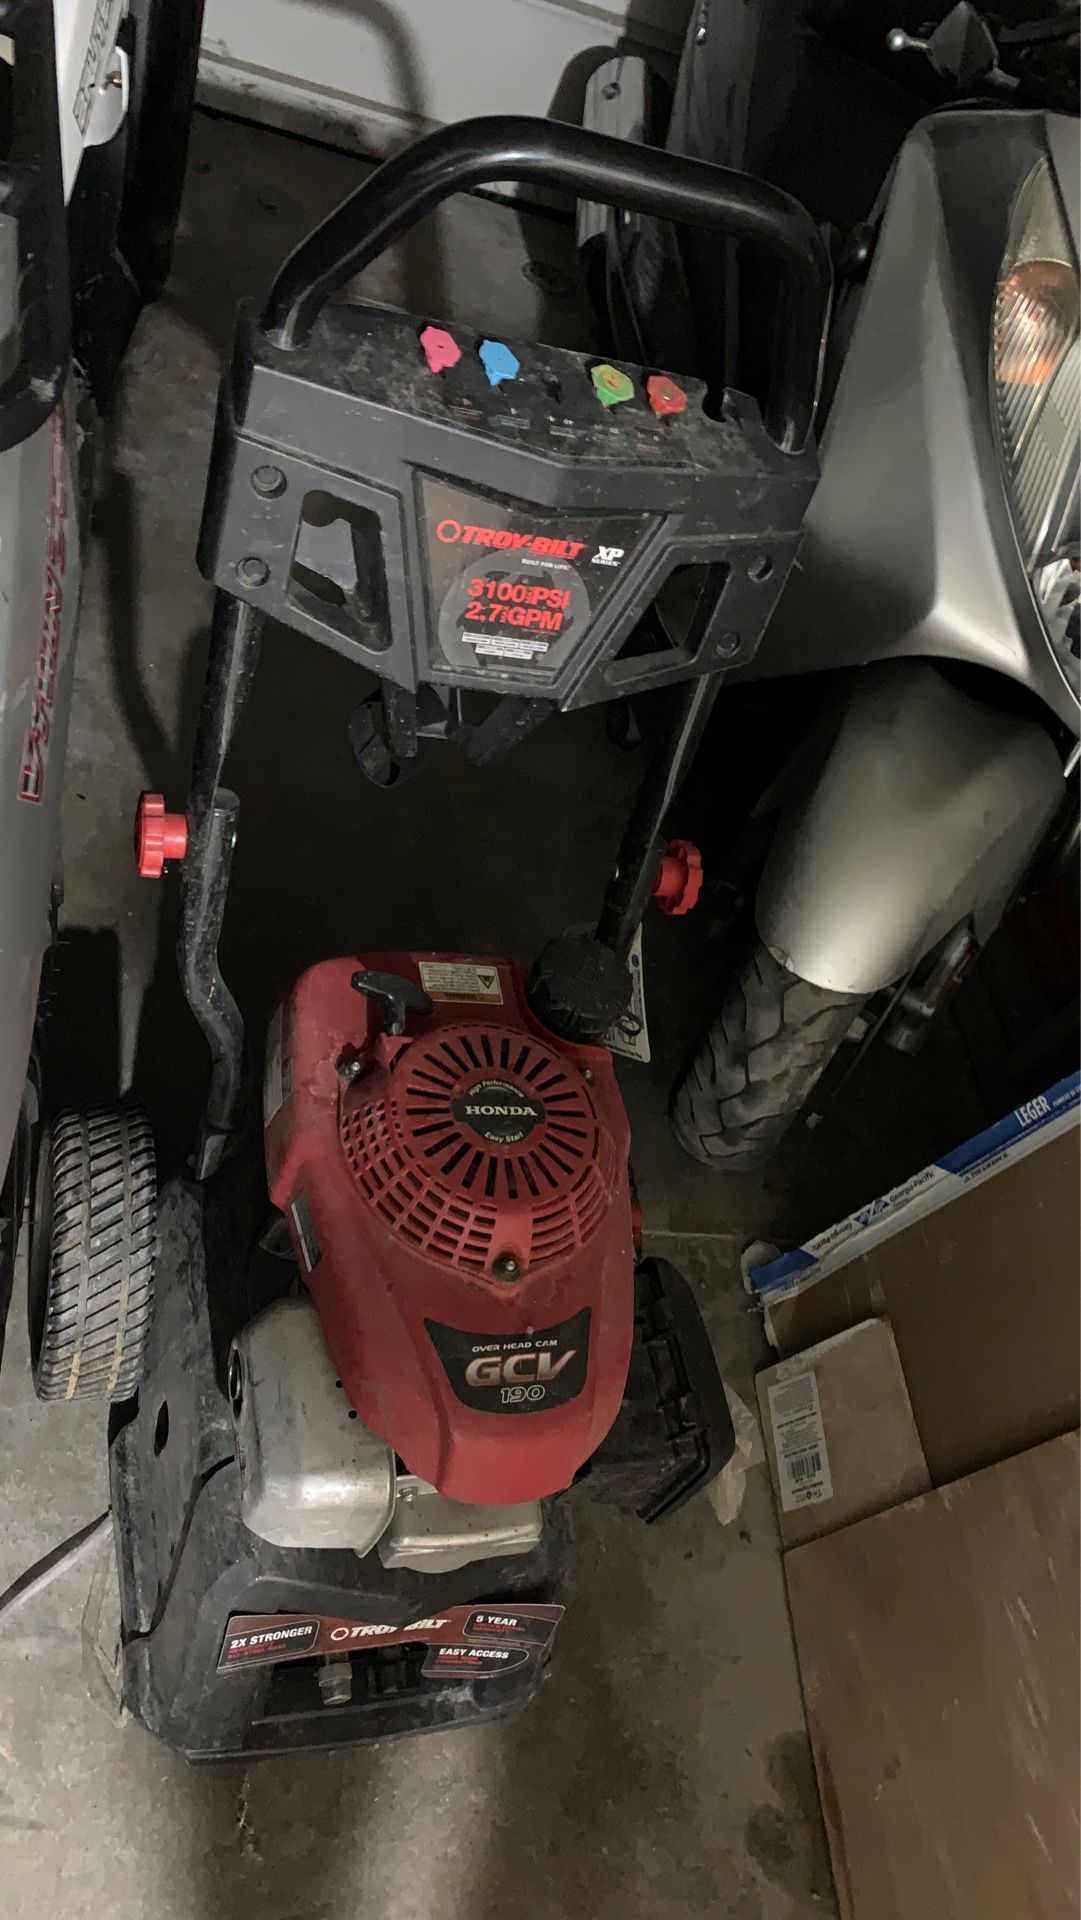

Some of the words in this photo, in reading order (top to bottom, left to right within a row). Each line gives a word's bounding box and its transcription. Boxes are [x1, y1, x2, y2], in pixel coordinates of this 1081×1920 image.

[461, 525, 587, 559] TROY-BILT
[593, 546, 625, 562] XP
[467, 578, 526, 604] 3100
[531, 586, 572, 609] PSI
[464, 601, 501, 623] 2.7
[507, 608, 564, 631] GPM
[465, 1105, 538, 1117] HONDA
[484, 1131, 504, 1143] Easy
[506, 1131, 524, 1142] Start
[472, 1344, 500, 1353] OVER
[503, 1341, 532, 1350] HEAD
[535, 1339, 558, 1348] CAM
[465, 1349, 577, 1387] GCV
[500, 1384, 546, 1404] 190
[476, 1614, 485, 1624] 5
[487, 1615, 518, 1627] YEAR
[230, 1637, 248, 1649] 2X
[249, 1625, 313, 1646] STRONGER
[438, 1647, 467, 1657] EASY
[468, 1648, 510, 1660] ACCESS
